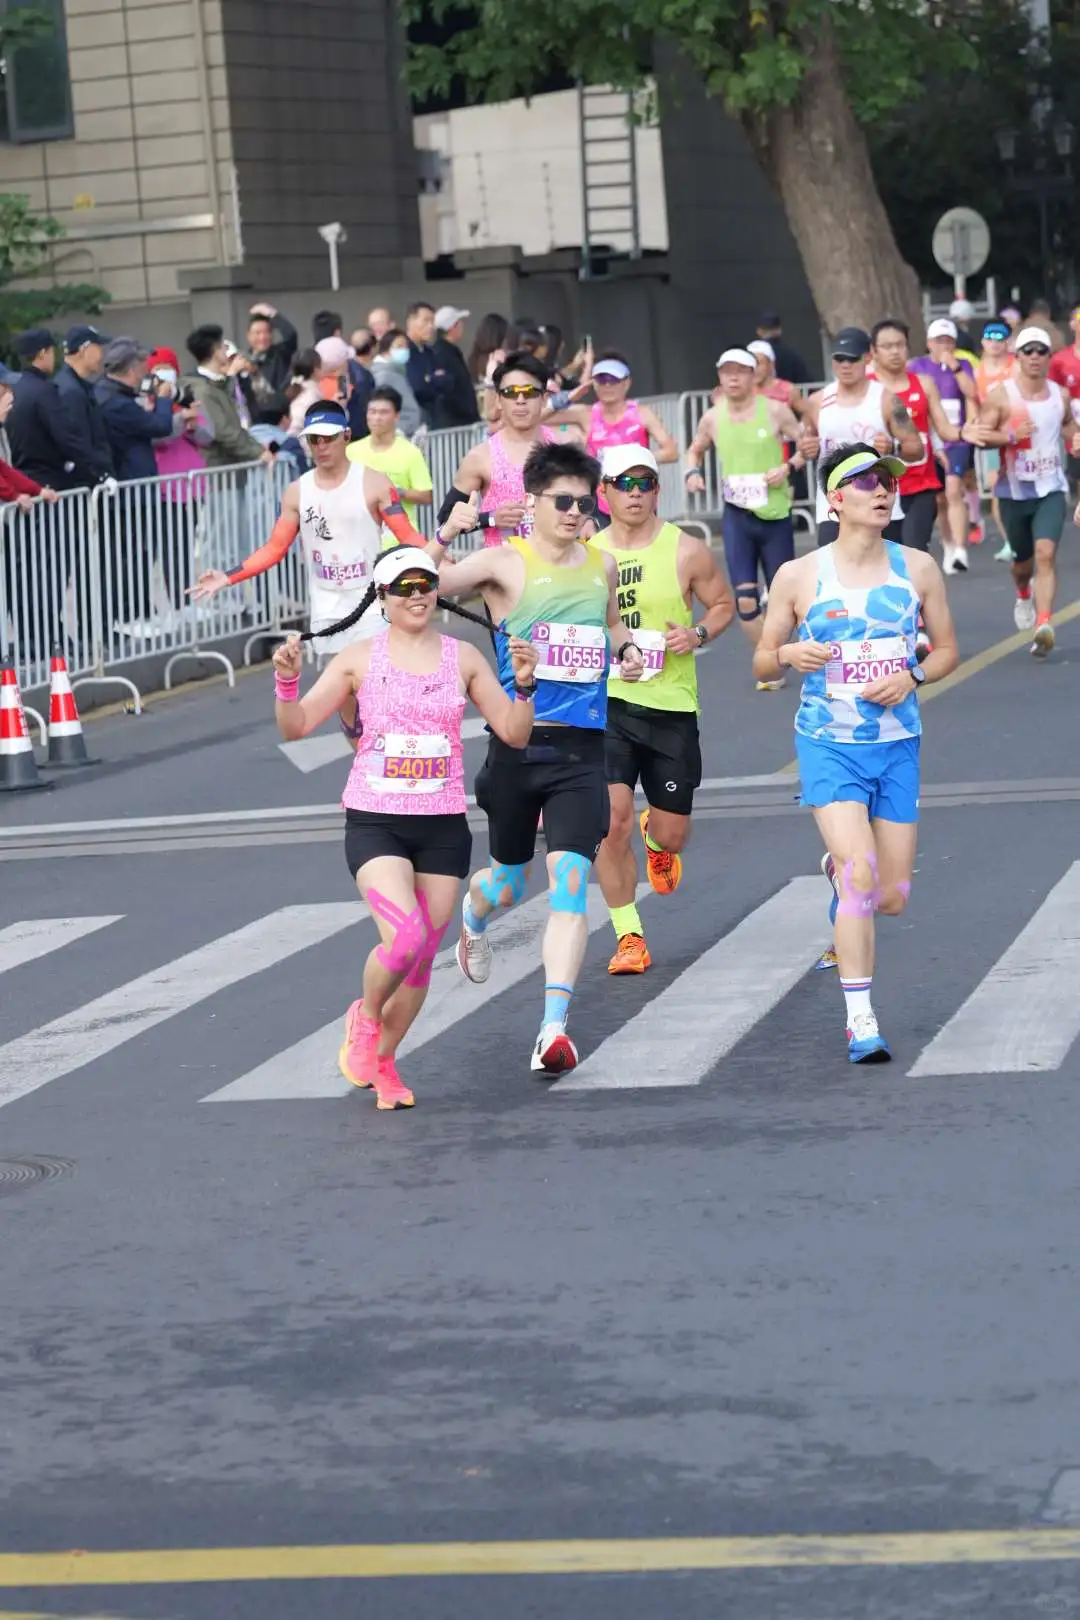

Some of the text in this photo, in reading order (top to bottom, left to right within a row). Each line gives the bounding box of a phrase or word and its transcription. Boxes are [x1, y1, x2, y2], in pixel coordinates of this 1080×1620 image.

[323, 565, 363, 580] 13544
[538, 627, 548, 639] D
[551, 645, 601, 668] 10555
[846, 660, 902, 683] 29005
[385, 757, 447, 778] 54013
